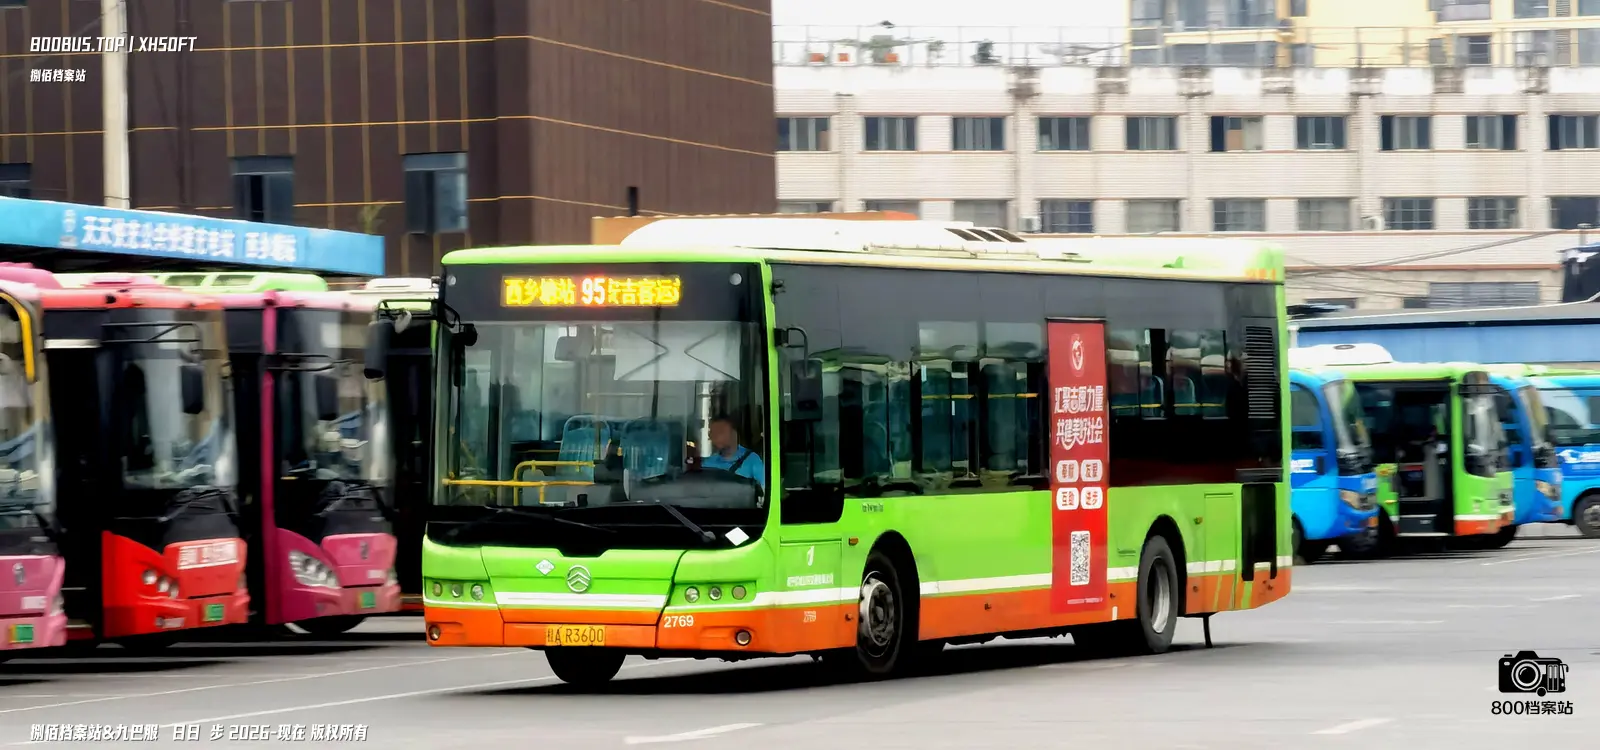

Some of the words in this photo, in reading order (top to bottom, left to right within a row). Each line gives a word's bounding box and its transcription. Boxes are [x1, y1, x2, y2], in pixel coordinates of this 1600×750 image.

[580, 277, 606, 305] 95
[1054, 385, 1104, 413] 汇聚志愿力量
[1055, 416, 1104, 450] 共建美好社会
[565, 628, 604, 643] R3600
[663, 615, 694, 628] 2769
